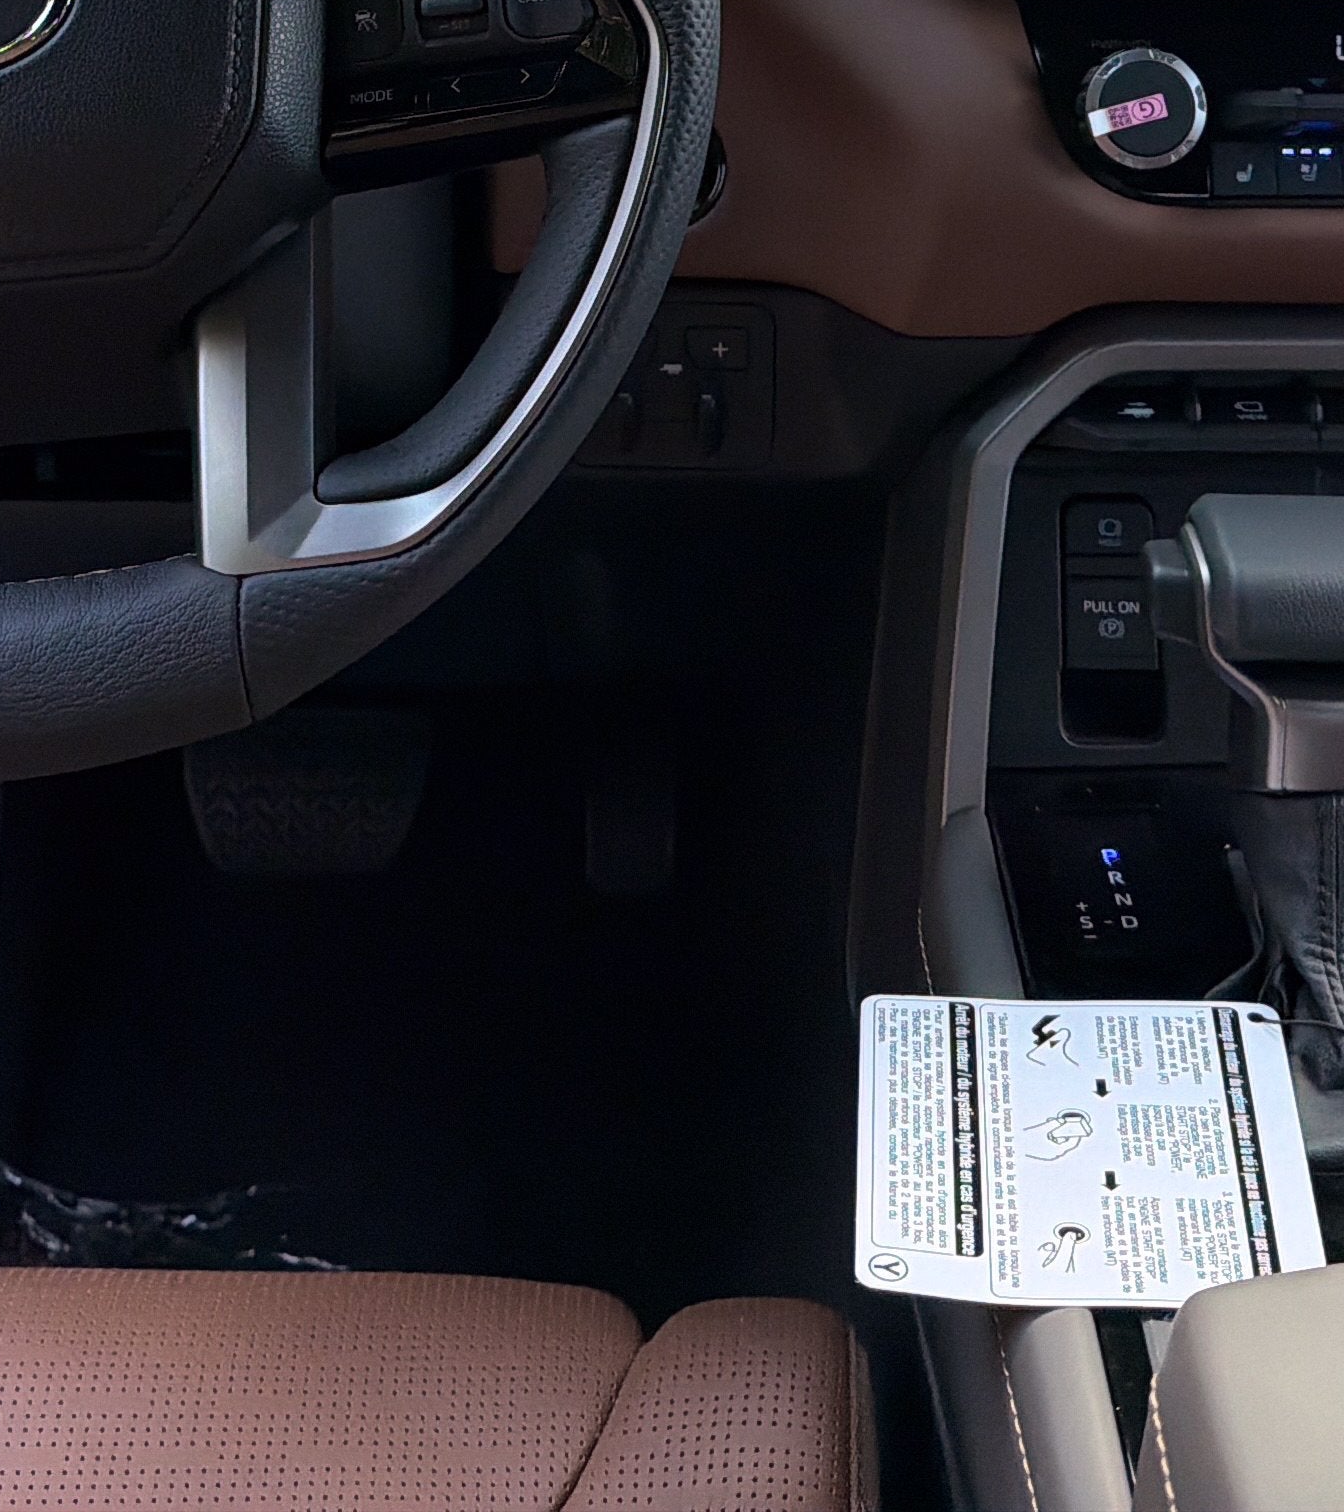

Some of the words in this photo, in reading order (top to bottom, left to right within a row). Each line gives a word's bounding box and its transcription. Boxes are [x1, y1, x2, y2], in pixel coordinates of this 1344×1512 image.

[350, 88, 394, 105] MODE
[1083, 599, 1114, 613] PULL
[1117, 600, 1140, 614] ON
[1101, 848, 1120, 867] P
[1107, 870, 1127, 886] R
[1114, 892, 1133, 906] N
[1079, 915, 1094, 929] S
[1120, 915, 1139, 929] D
[955, 1004, 971, 1026] Arrêt
[956, 1026, 970, 1038] du
[956, 1039, 970, 1072] moteur
[957, 1077, 972, 1090] du
[954, 1091, 974, 1131] système
[955, 1132, 975, 1169] hybride
[960, 1169, 972, 1184] en
[960, 1184, 973, 1203] cas
[957, 1204, 978, 1258] d'urgence
[874, 1261, 900, 1277] Y
